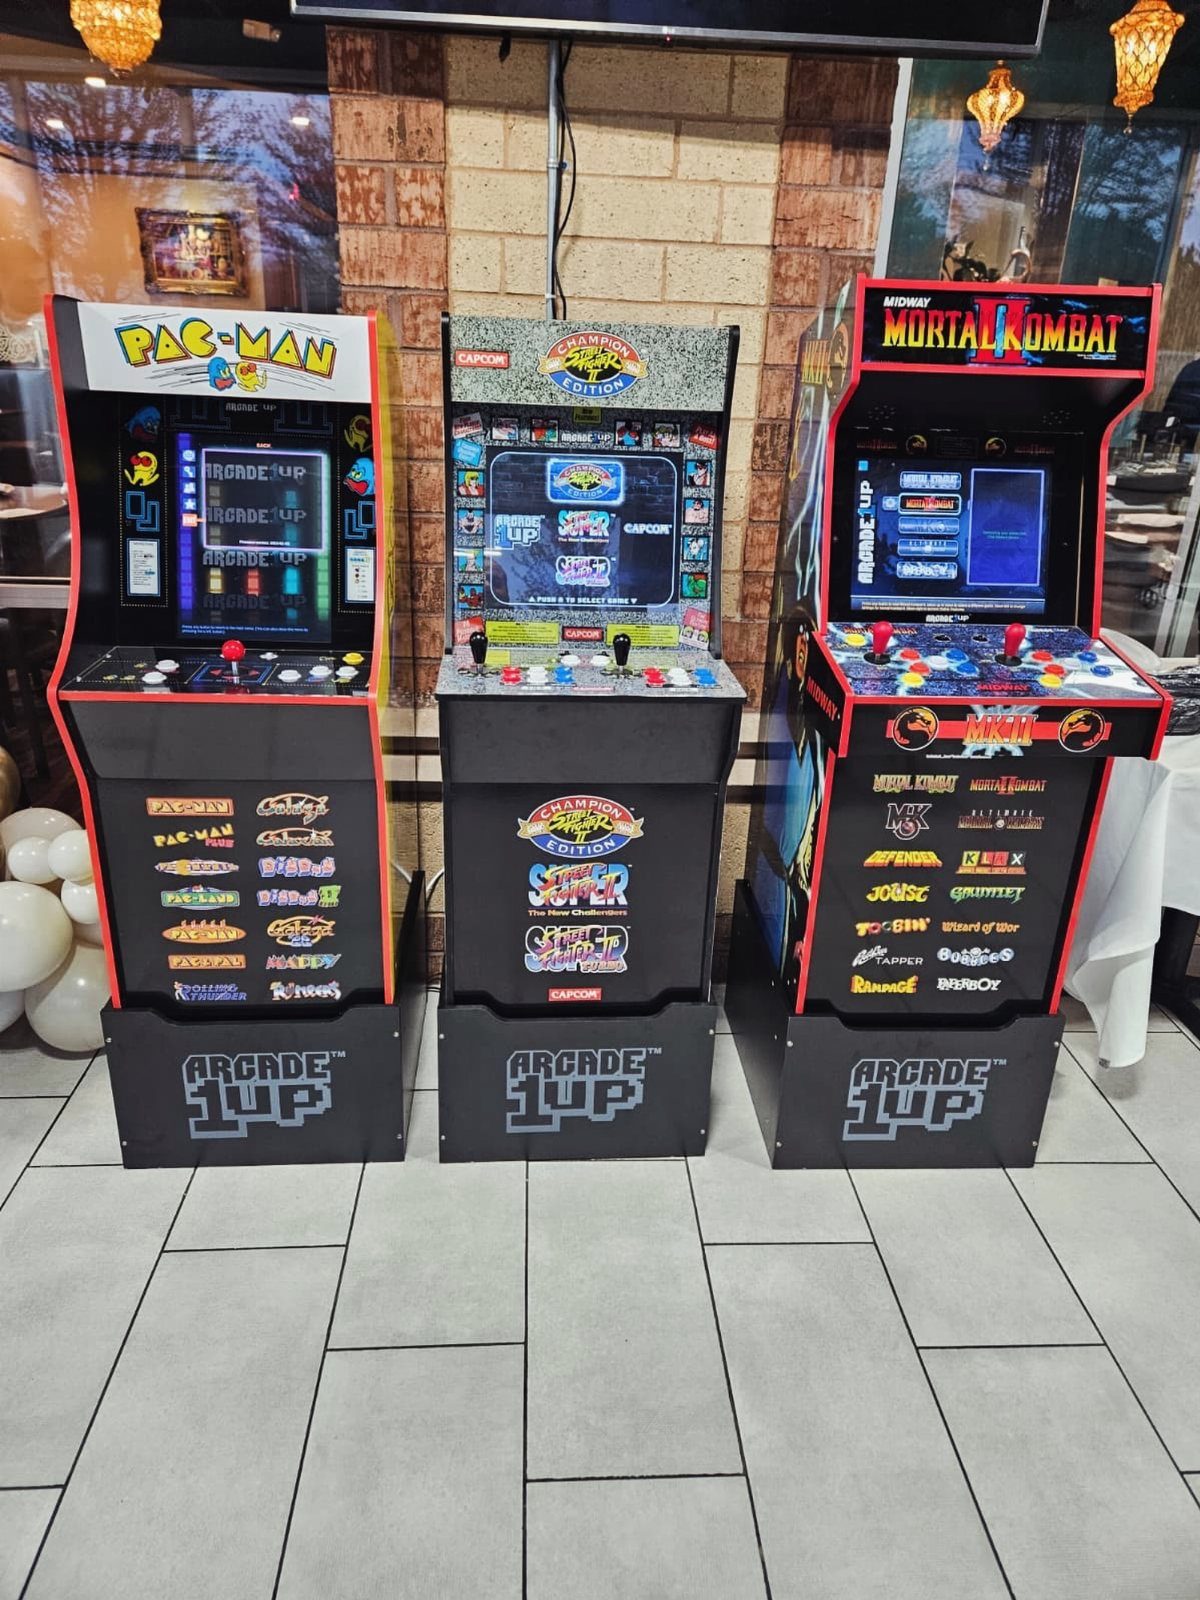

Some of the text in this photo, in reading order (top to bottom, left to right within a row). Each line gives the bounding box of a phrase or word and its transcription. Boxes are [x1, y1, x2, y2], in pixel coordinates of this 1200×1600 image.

[883, 296, 931, 308] MIDWAY
[882, 308, 1123, 353] MORTAL KOMBAT
[114, 317, 337, 379] PAC-MAN
[558, 335, 630, 358] CHAMPION
[458, 353, 505, 365] CAPCOM
[564, 346, 603, 366] STREET
[578, 352, 622, 371] FIGHTER
[562, 378, 624, 394] EDITION
[623, 523, 669, 535] CAPCOM
[565, 629, 600, 638] CAPCOM
[977, 683, 1028, 692] MIDWAY
[807, 676, 838, 722] MIDWAY
[873, 774, 960, 794] MORTAL KOMBAT
[970, 779, 1048, 792] MORTAL KOMBAT
[152, 801, 230, 813] PAC-MAN
[540, 800, 623, 819] CHAMPION
[549, 809, 594, 830] STREET
[560, 812, 614, 834] FIGHTER
[153, 823, 235, 847] PAC-MAN
[204, 838, 235, 848] PLUS
[546, 839, 616, 855] EDITION
[863, 850, 943, 867] DEFENDER
[963, 851, 1026, 867] KLAX
[167, 894, 235, 904] PAC-LAND
[866, 882, 930, 902] JOUST
[950, 887, 1025, 904] GAUNTLET
[528, 909, 546, 917] The
[571, 909, 628, 917] Challengers
[171, 930, 239, 940] PAC-MAN
[942, 921, 1020, 934] Wizard of Wor
[535, 926, 600, 954] STREET
[172, 956, 200, 967] PAC
[213, 956, 243, 967] PAL
[266, 954, 341, 969] MAPPY
[875, 957, 924, 965] TAPPER
[182, 984, 239, 1000] ROLLING
[937, 978, 1001, 991] PAPERBOY
[191, 992, 248, 1000] THUNDER
[551, 990, 598, 999] CAPCOM
[182, 1052, 331, 1085] ARCADE
[506, 1048, 646, 1079] ARCADE
[851, 1059, 991, 1090] ARCADE
[186, 1079, 332, 1139] 1UP
[507, 1075, 644, 1133] 1UP
[843, 1083, 984, 1141] 1UP
